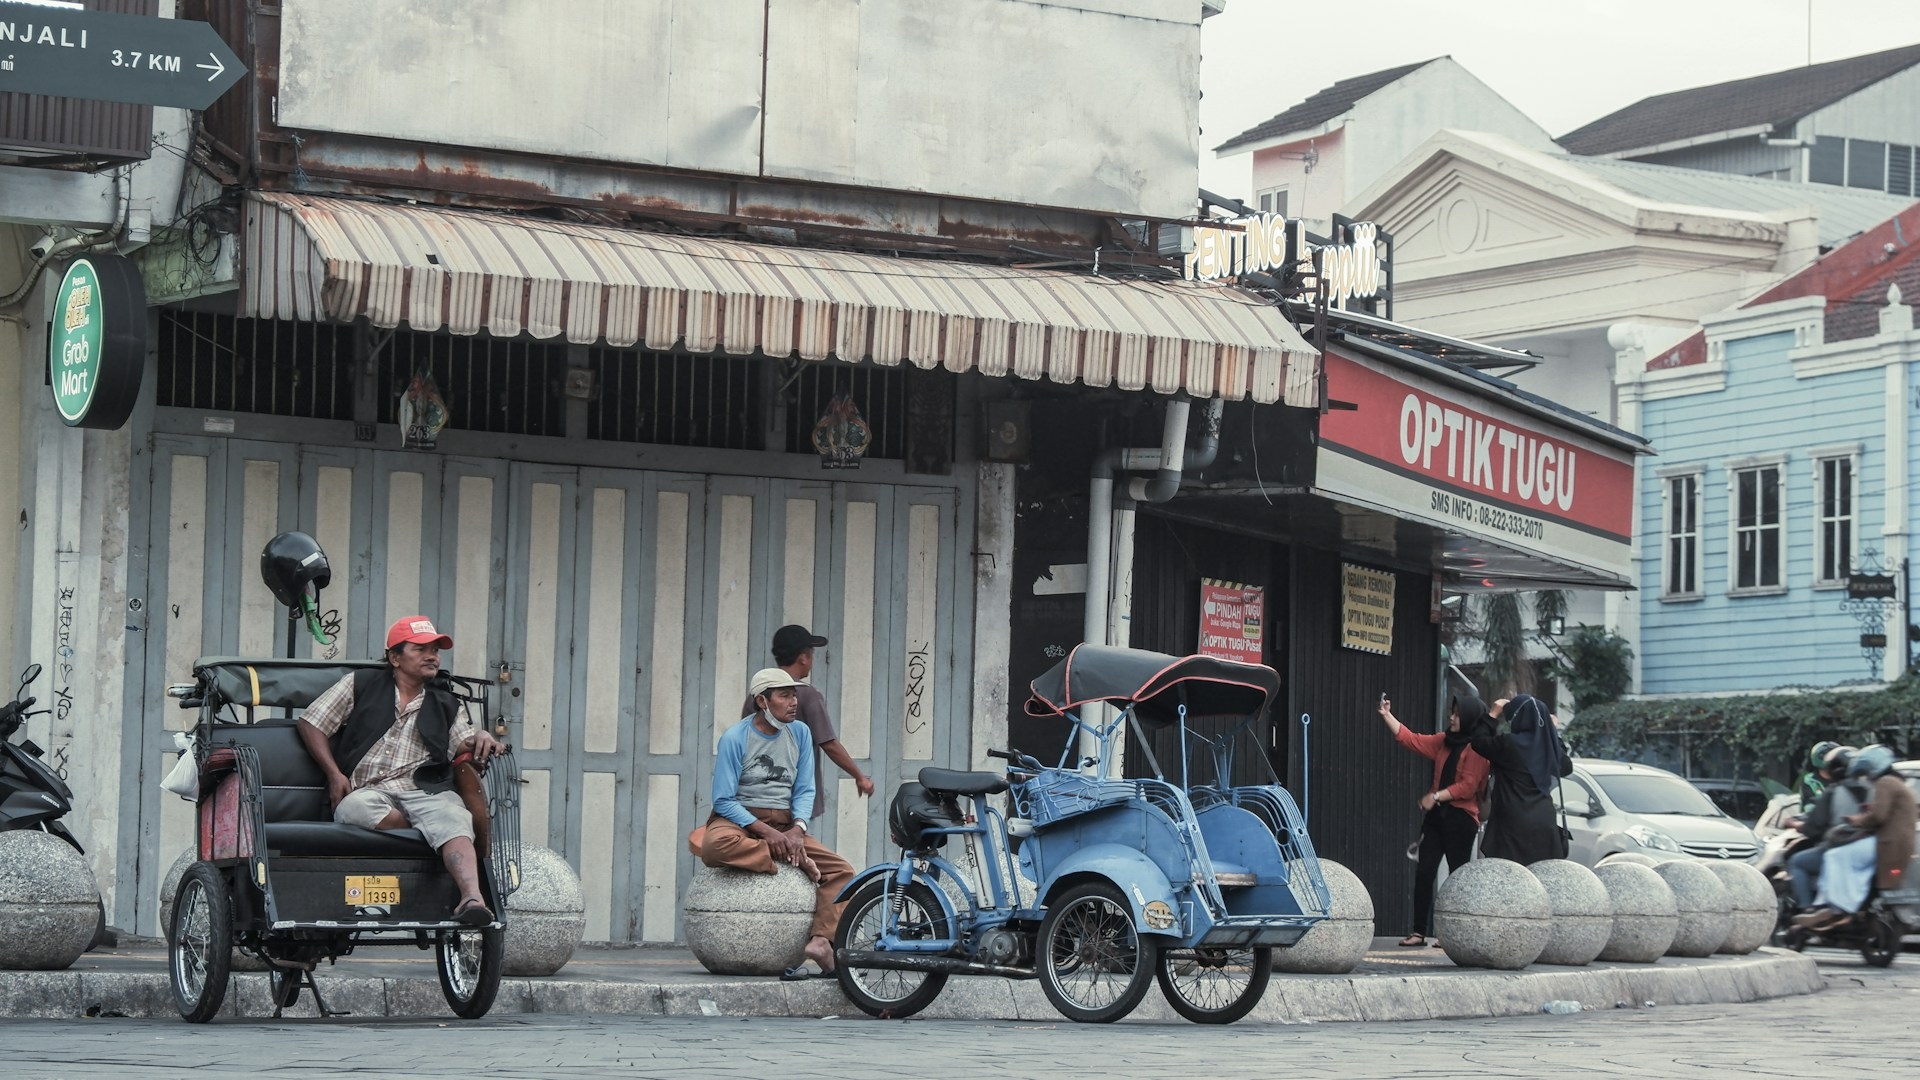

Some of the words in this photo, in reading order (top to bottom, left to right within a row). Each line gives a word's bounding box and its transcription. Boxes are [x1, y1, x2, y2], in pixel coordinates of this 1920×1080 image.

[111, 49, 143, 69] 3.7
[149, 53, 181, 72] KM
[1184, 212, 1287, 281] PENTING
[70, 285, 91, 308] OLEH
[63, 334, 89, 367] Grab
[61, 368, 88, 398] Mart
[1400, 393, 1496, 490] OPTIK
[1498, 427, 1575, 512] TUGU
[1431, 490, 1450, 514] SMS
[1452, 497, 1472, 521] INFO
[1480, 505, 1544, 541] 08-222-333-2070
[1347, 571, 1367, 590] SEDANG
[1216, 602, 1242, 619] PINDAH
[1245, 603, 1261, 617] TUGU
[1348, 608, 1361, 625] OPTIK
[1362, 611, 1375, 628] TUGU
[1375, 614, 1390, 630] PUSAT
[1209, 635, 1228, 649] OPTIK
[1228, 637, 1245, 651] TUGU
[1245, 639, 1262, 652] Pusat
[41, 793, 60, 809] HONDA
[368, 891, 396, 904] 1399
